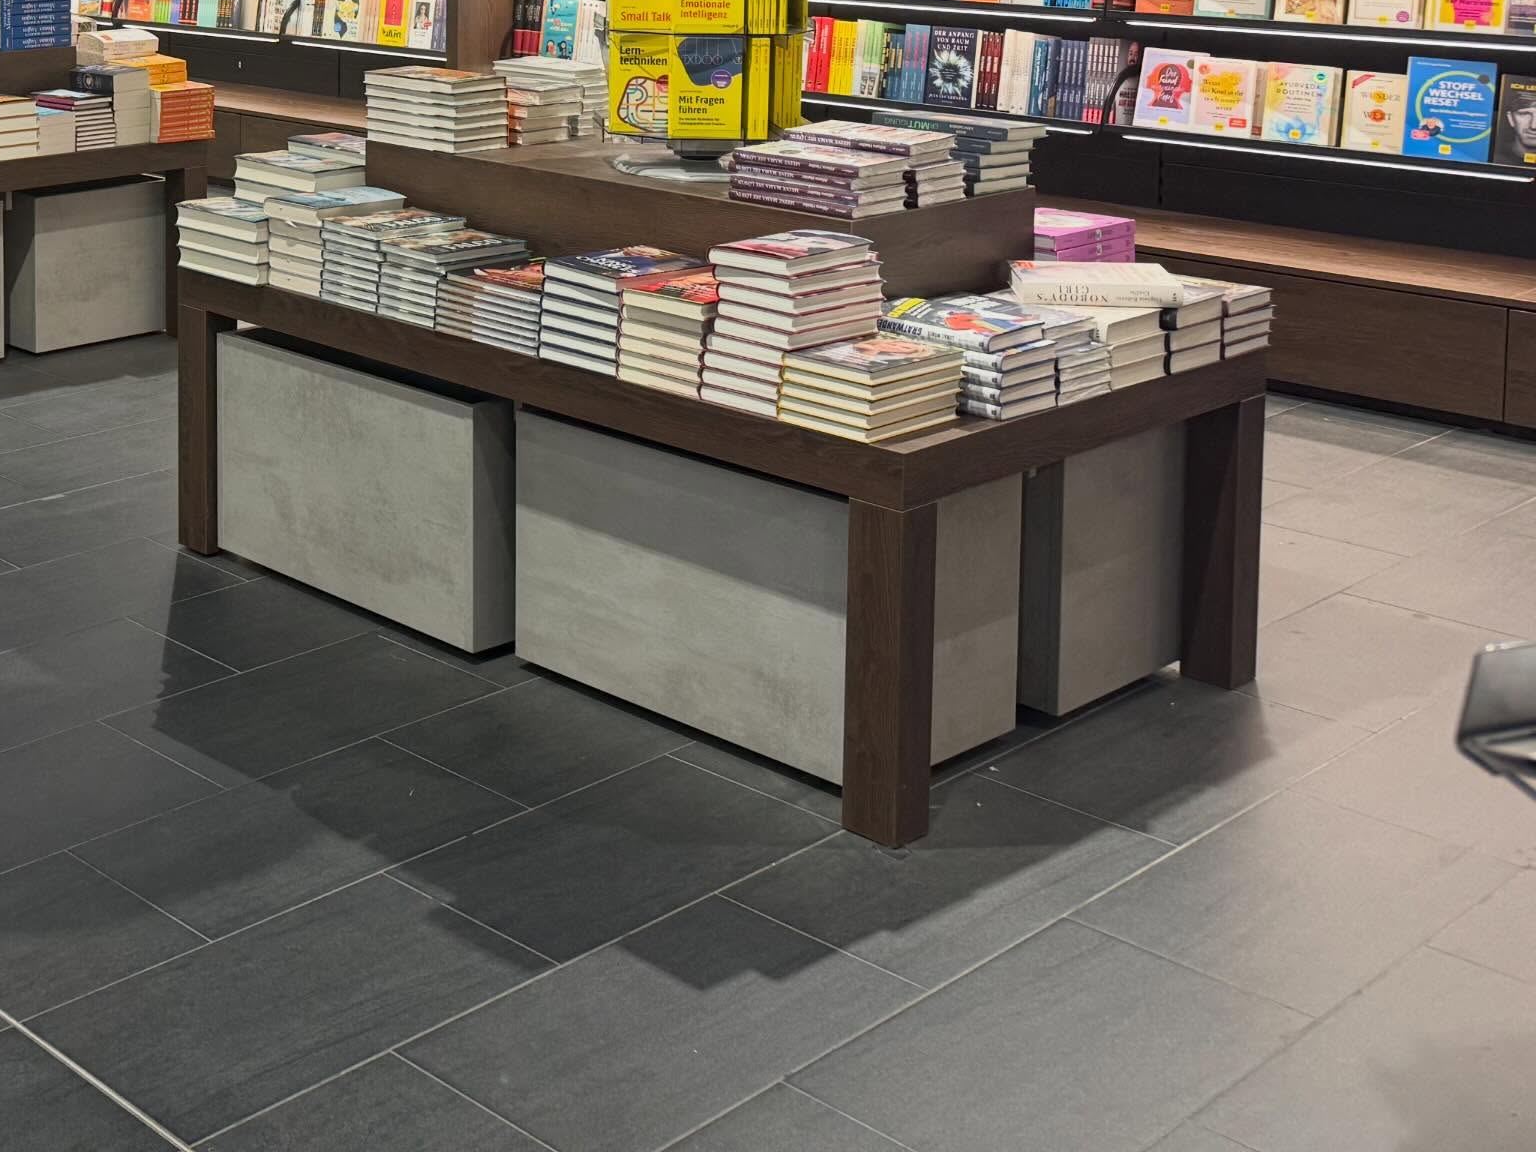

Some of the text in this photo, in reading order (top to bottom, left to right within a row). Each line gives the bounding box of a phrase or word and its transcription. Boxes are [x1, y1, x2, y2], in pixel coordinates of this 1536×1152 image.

[680, 0, 731, 9] Emotionale
[621, 11, 672, 23] Small Talk
[680, 9, 729, 21] Intelligenz
[934, 29, 975, 38] DER ANFANG
[951, 37, 970, 46] RAUM
[619, 45, 646, 55] Lern-
[937, 43, 969, 52] UND ZEIT
[619, 55, 668, 66] techniken
[1279, 81, 1321, 90] AYURVEDA
[1438, 80, 1477, 91] STOFF
[1276, 87, 1324, 97] ROUTINEN
[1428, 89, 1485, 102] WECHSEL
[678, 95, 725, 107] Mit Fragen
[1423, 96, 1461, 108] RESET
[678, 105, 708, 115] führen
[1058, 284, 1092, 296] GIRL
[1036, 292, 1109, 304] NOBODY'S
